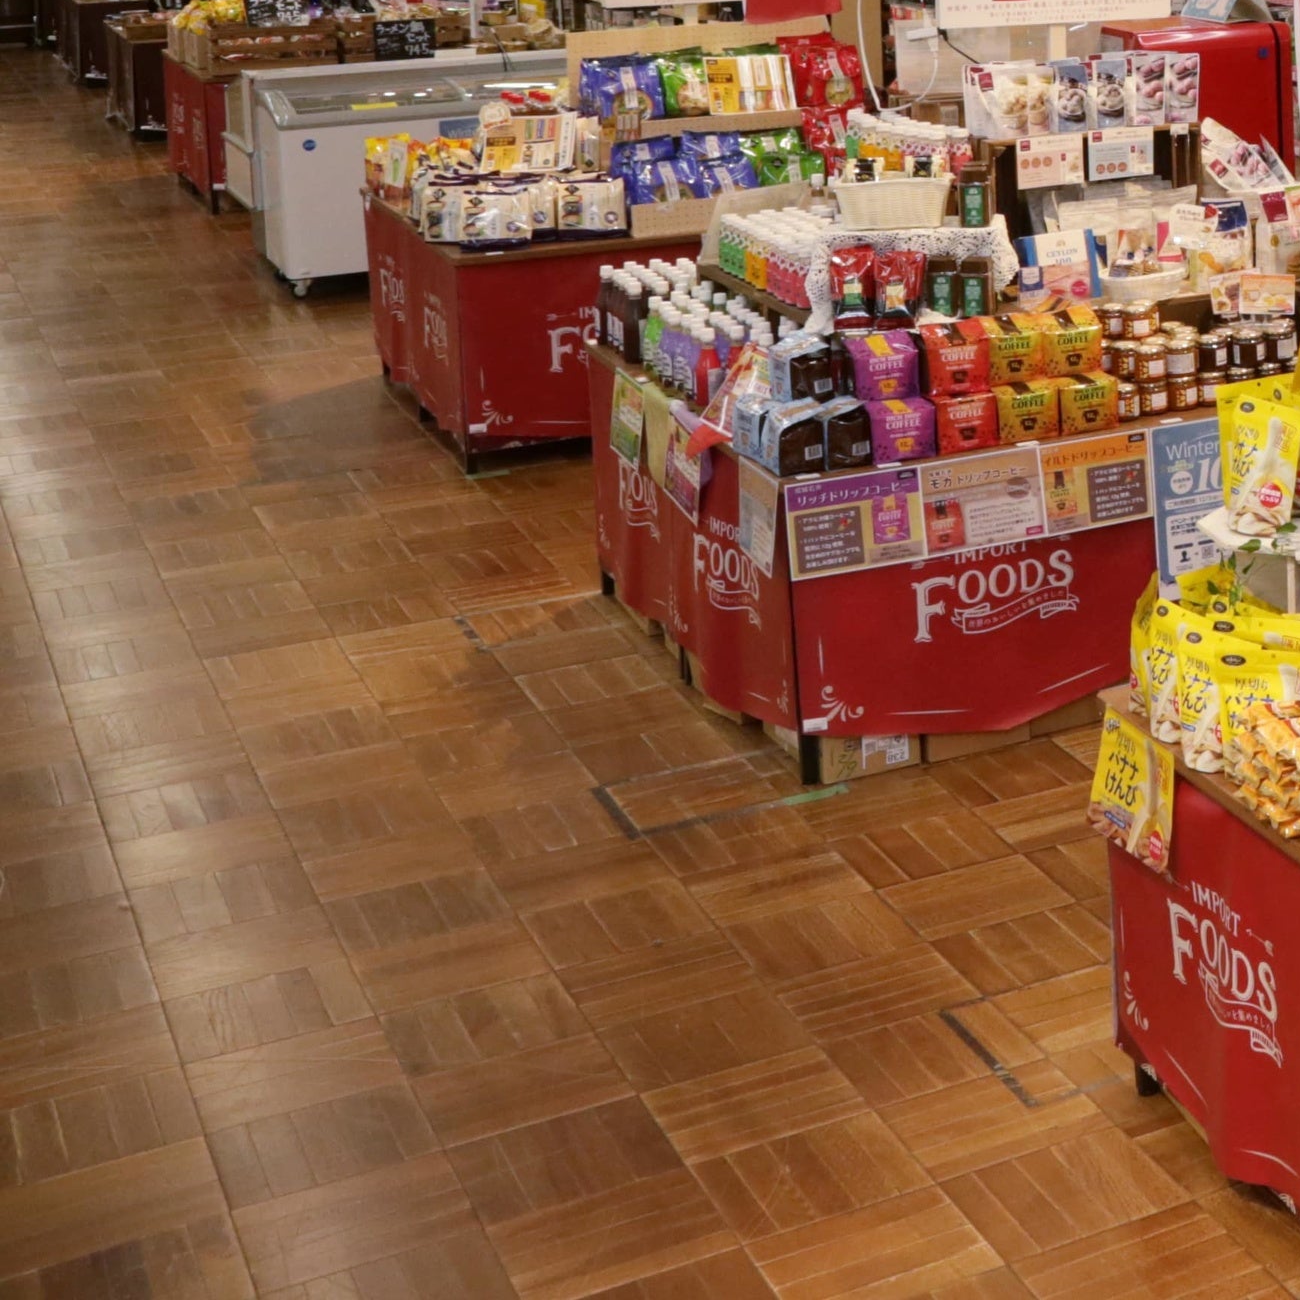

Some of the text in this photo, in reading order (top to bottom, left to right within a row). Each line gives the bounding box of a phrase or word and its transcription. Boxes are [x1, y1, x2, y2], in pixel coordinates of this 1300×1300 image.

[869, 361, 904, 372] COFFEE
[885, 419, 922, 431] COFFEE
[929, 466, 1027, 489] モカ ドリップコーヒー
[796, 479, 914, 507] リッチドリップコーヒー
[953, 538, 1029, 566] IMPORT
[910, 548, 1076, 644] FOODS
[1115, 731, 1137, 758] 厚切り
[1108, 750, 1139, 781] バナナ
[1104, 770, 1138, 807] けんぴ
[1191, 880, 1241, 938] IMPORT
[1167, 897, 1278, 1024] FOODS
